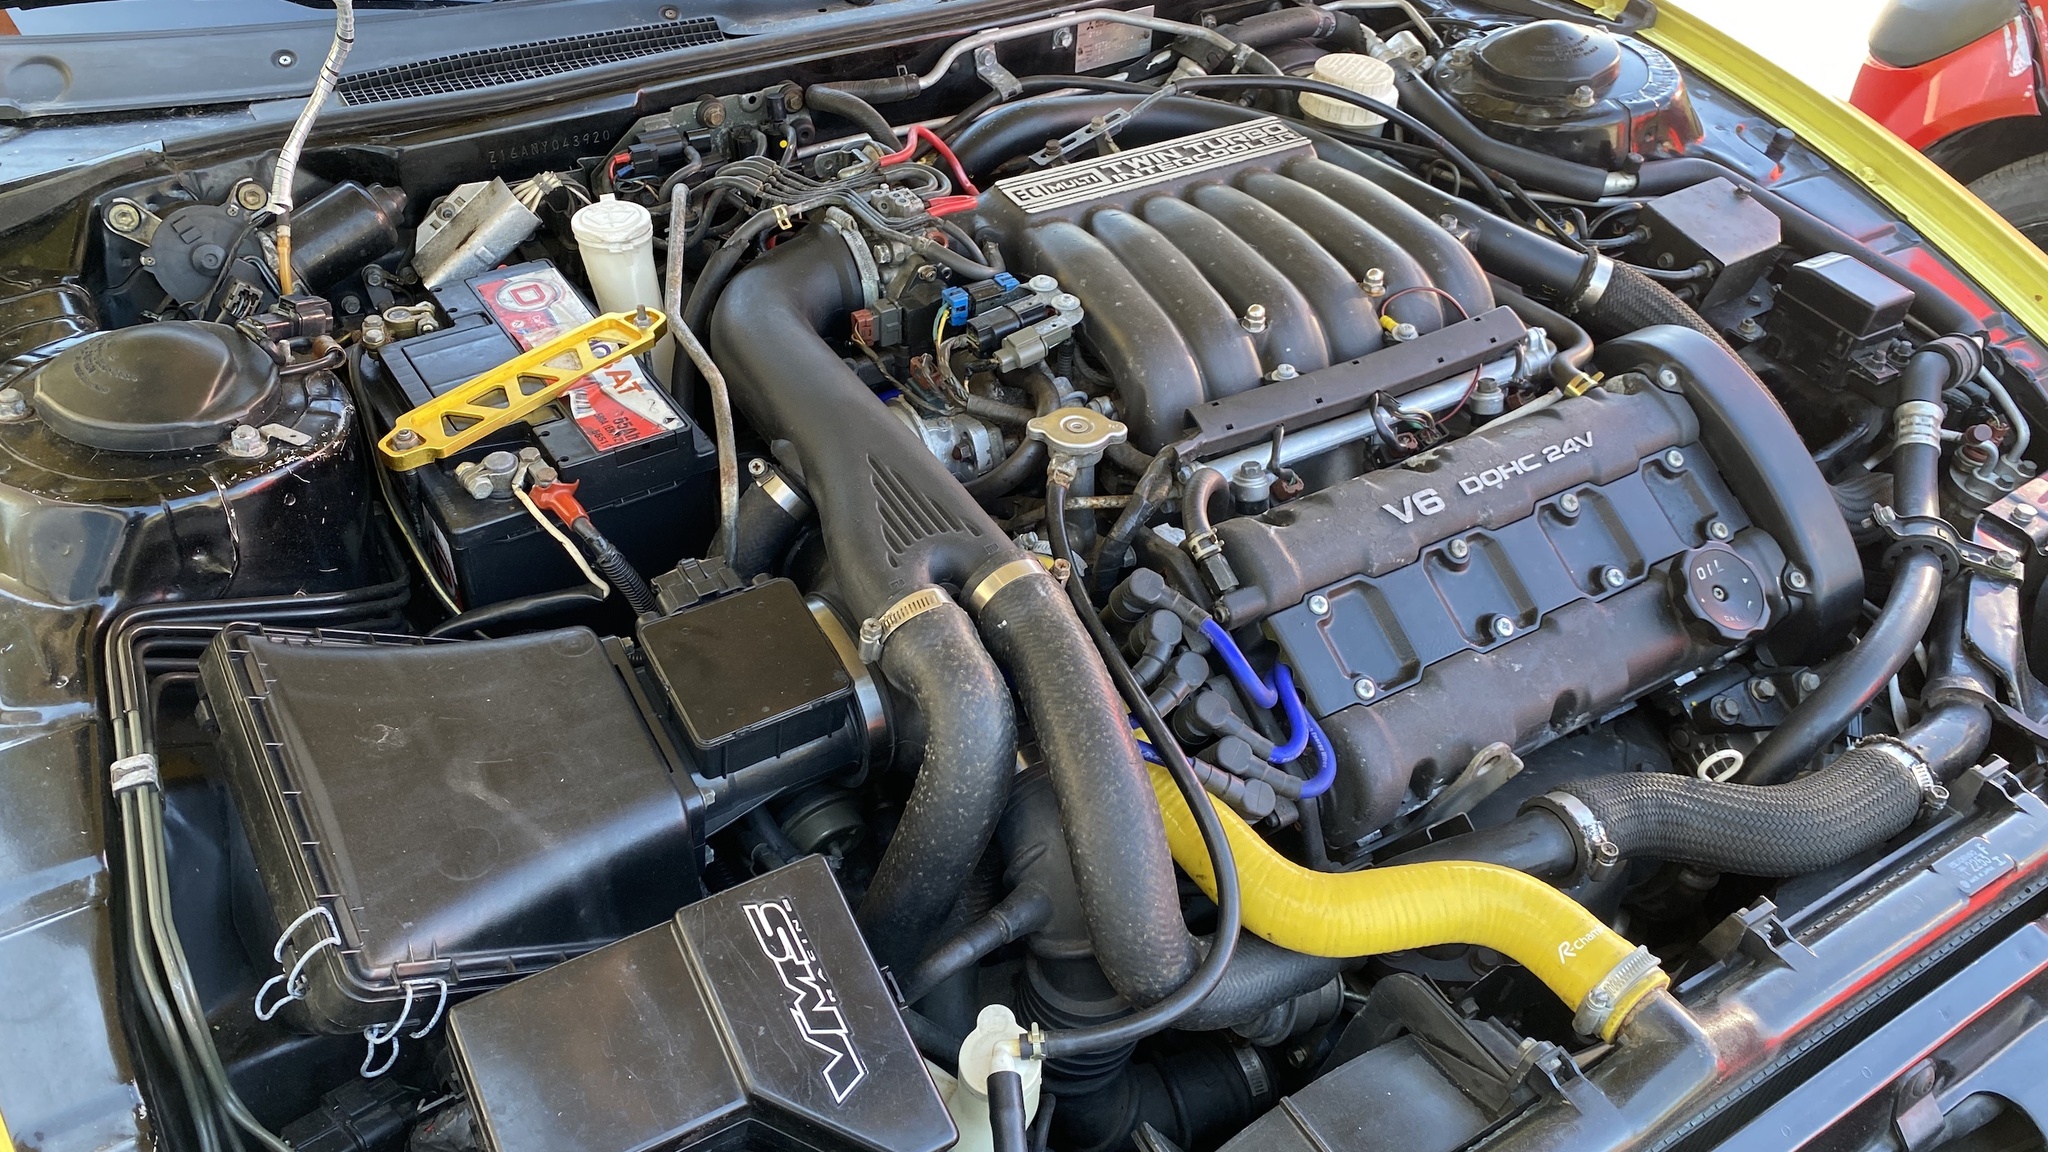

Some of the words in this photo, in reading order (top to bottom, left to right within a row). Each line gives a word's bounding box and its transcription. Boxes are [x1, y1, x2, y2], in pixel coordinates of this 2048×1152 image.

[1102, 148, 1184, 174] TWIN
[1186, 122, 1291, 154] TURBO
[1112, 131, 1302, 184] INTERCOOLER
[1048, 173, 1100, 195] MULTI
[602, 356, 645, 395] AT
[1381, 487, 1446, 524] V6
[1457, 452, 1543, 496] DOHC
[1541, 430, 1594, 464] 24V
[1695, 559, 1725, 581] OIL
[742, 902, 865, 1105] VMS
